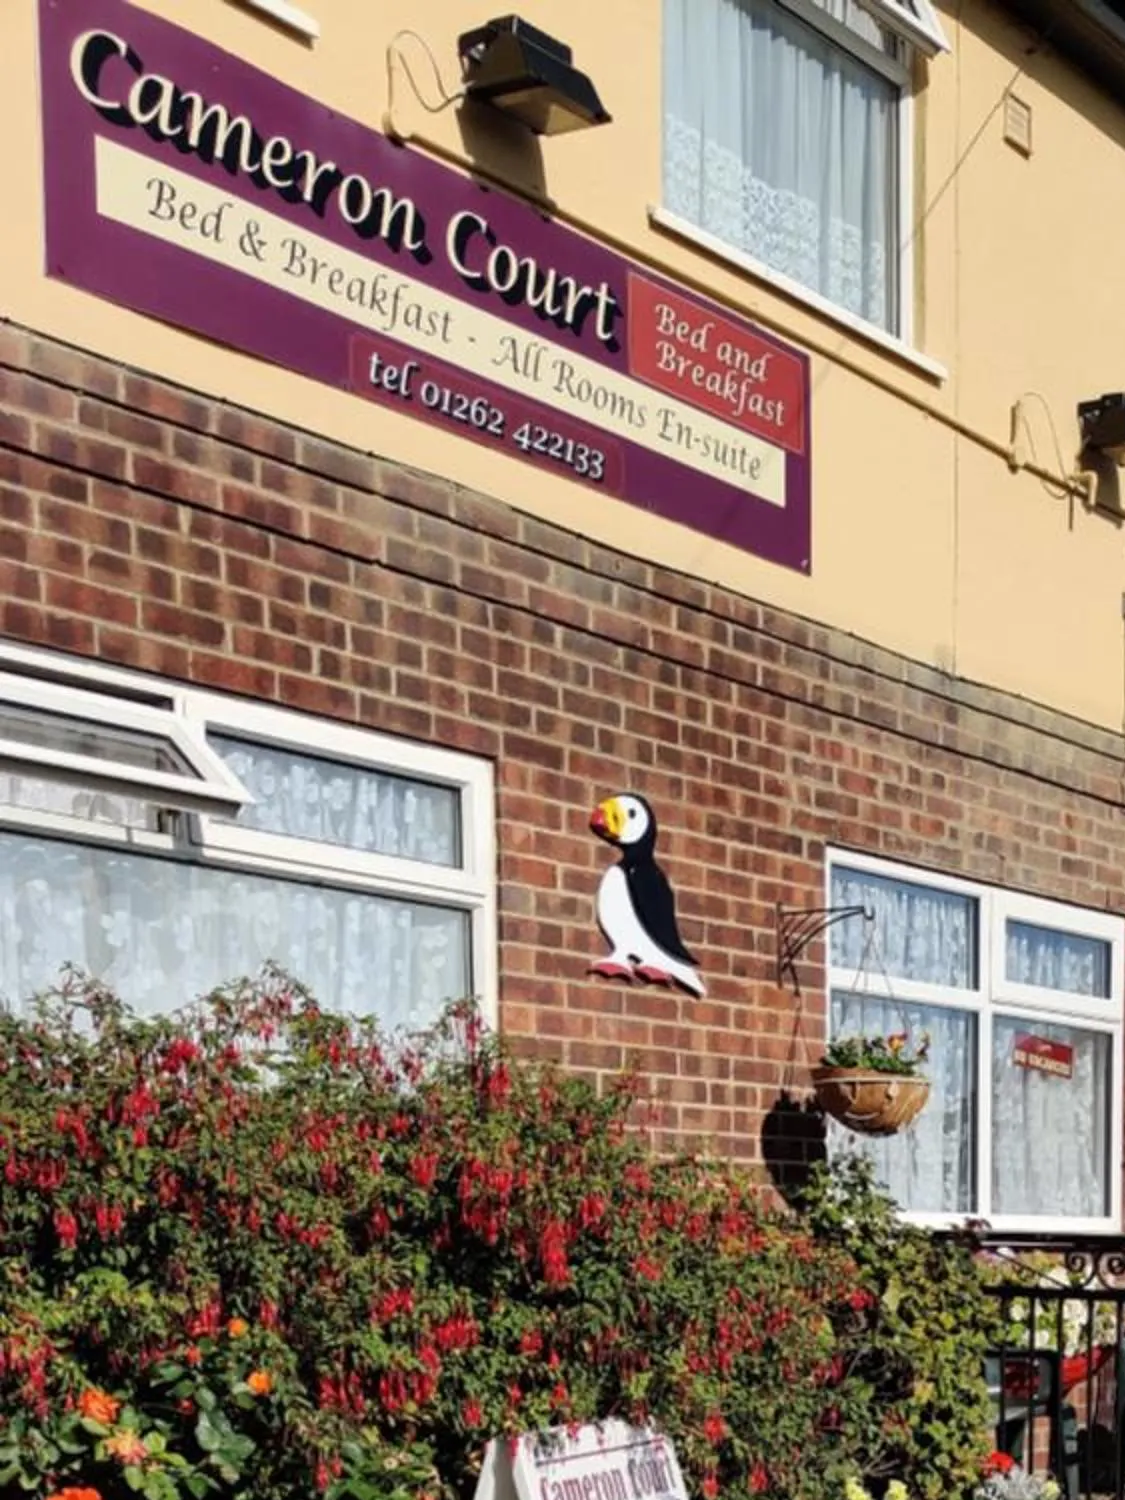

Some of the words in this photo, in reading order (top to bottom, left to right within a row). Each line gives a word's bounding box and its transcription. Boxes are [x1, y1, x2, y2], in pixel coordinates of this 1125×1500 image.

[69, 28, 426, 252] Cameron
[446, 210, 617, 342] Court
[146, 178, 233, 243] Bed
[238, 218, 268, 262] &
[280, 237, 453, 343] Breakfast
[490, 335, 549, 382] All
[552, 359, 648, 430] Rooms
[656, 407, 762, 481] En-suite
[654, 302, 716, 353] Bed
[716, 341, 773, 383] and
[654, 340, 786, 427] Breakfast
[369, 351, 417, 396] tel
[420, 380, 505, 436] 01262
[511, 421, 606, 481] 422133
[627, 1453, 677, 1500] Court
